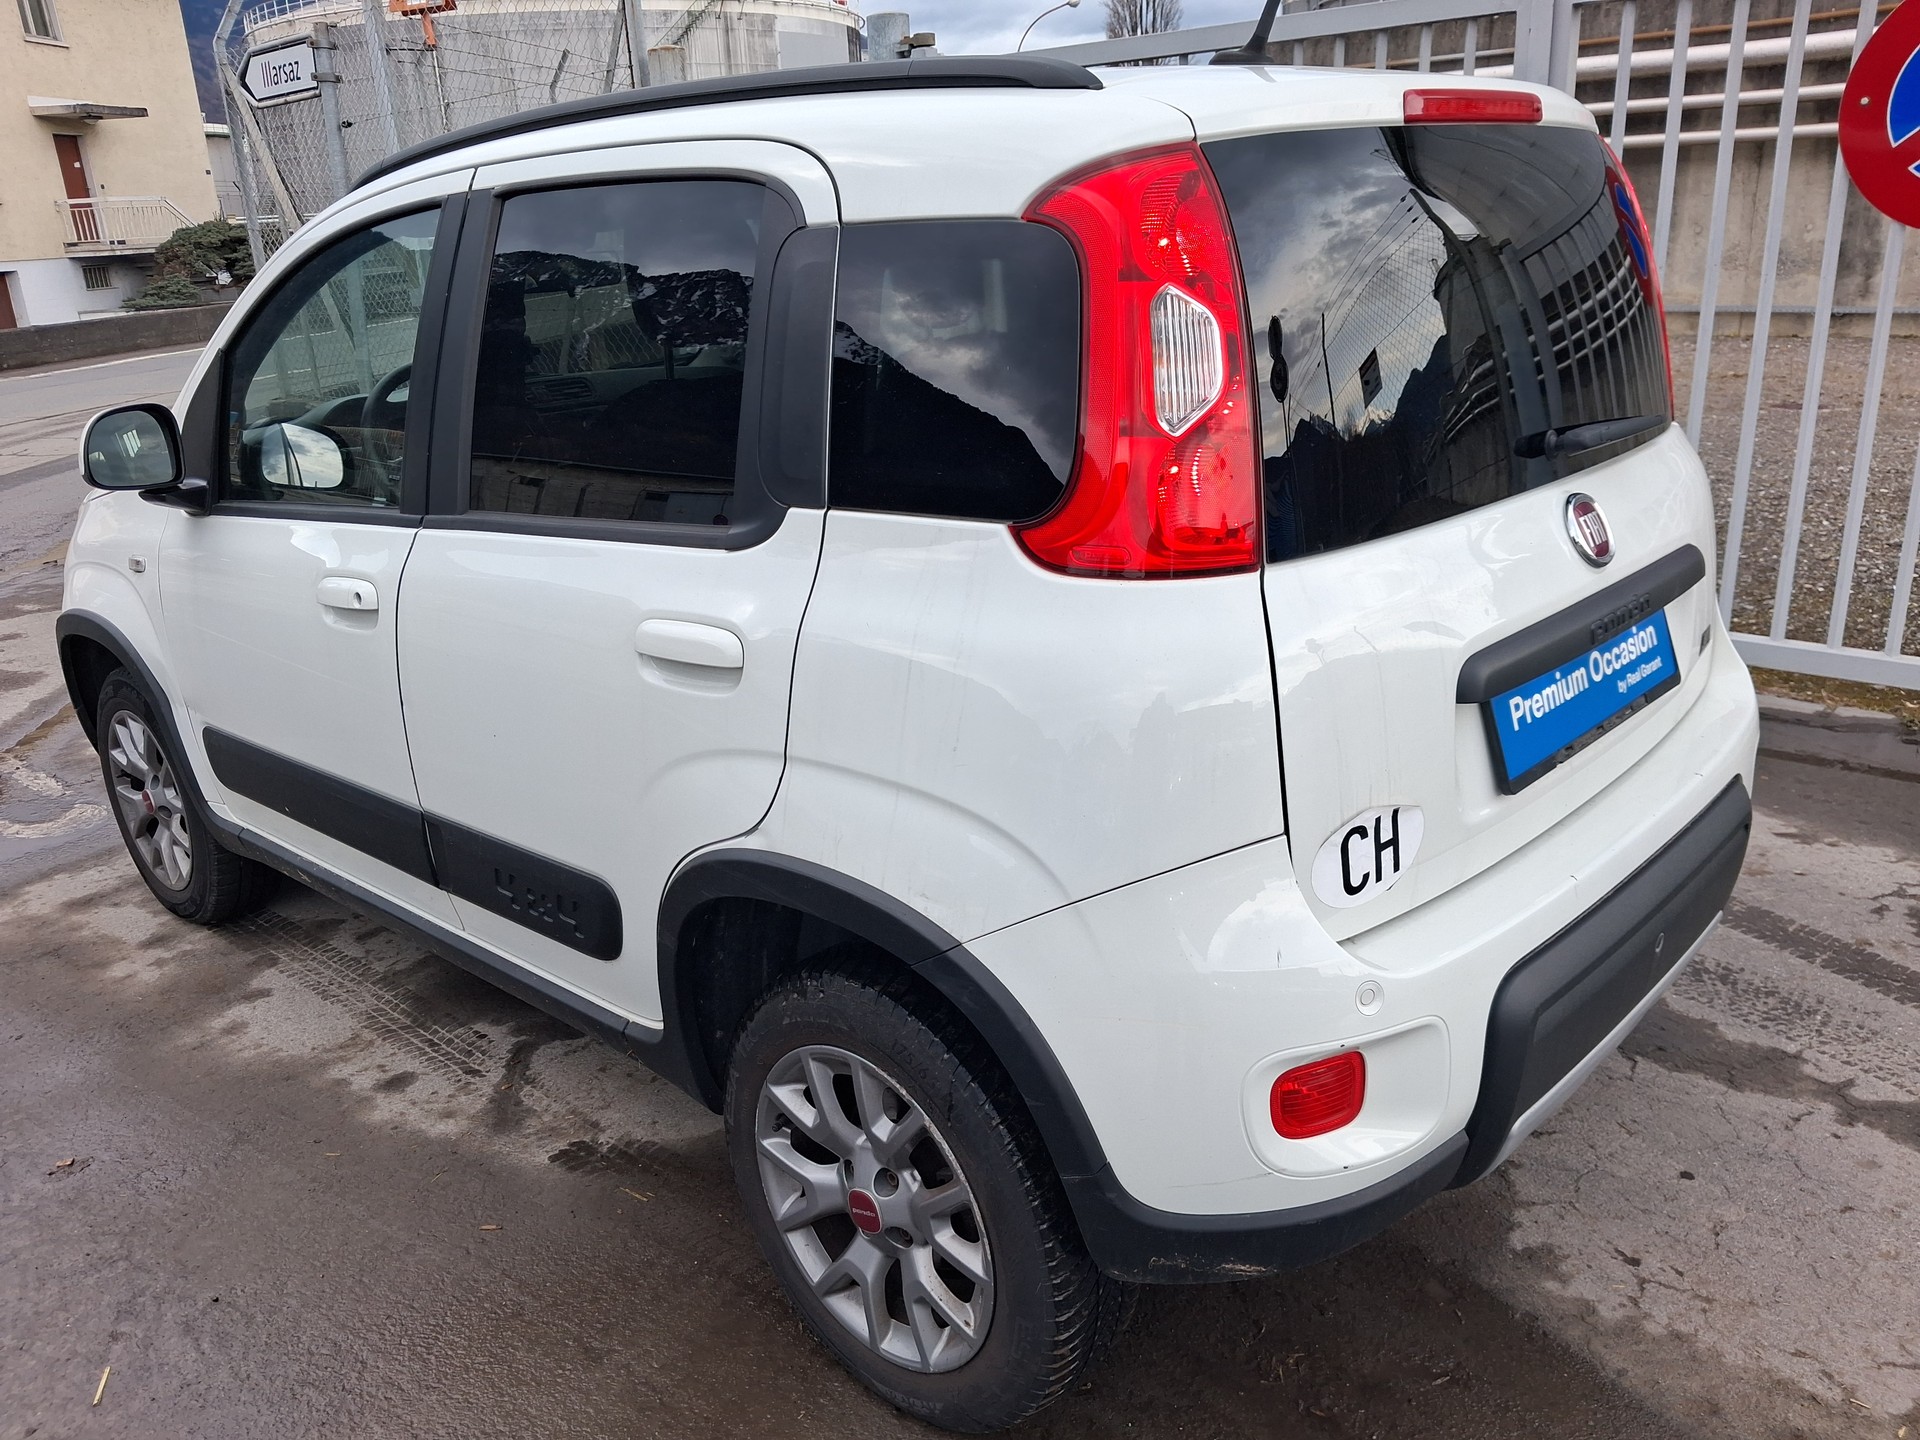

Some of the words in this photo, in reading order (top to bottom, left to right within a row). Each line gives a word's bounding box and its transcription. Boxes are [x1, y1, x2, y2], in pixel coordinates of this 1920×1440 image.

[260, 60, 302, 88] Illarsaz
[1579, 510, 1608, 548] FIAT
[1509, 666, 1589, 731] Premium
[1589, 625, 1658, 682] Occasion
[1617, 679, 1628, 694] by
[1626, 667, 1643, 688] Real
[1340, 806, 1400, 896] CH
